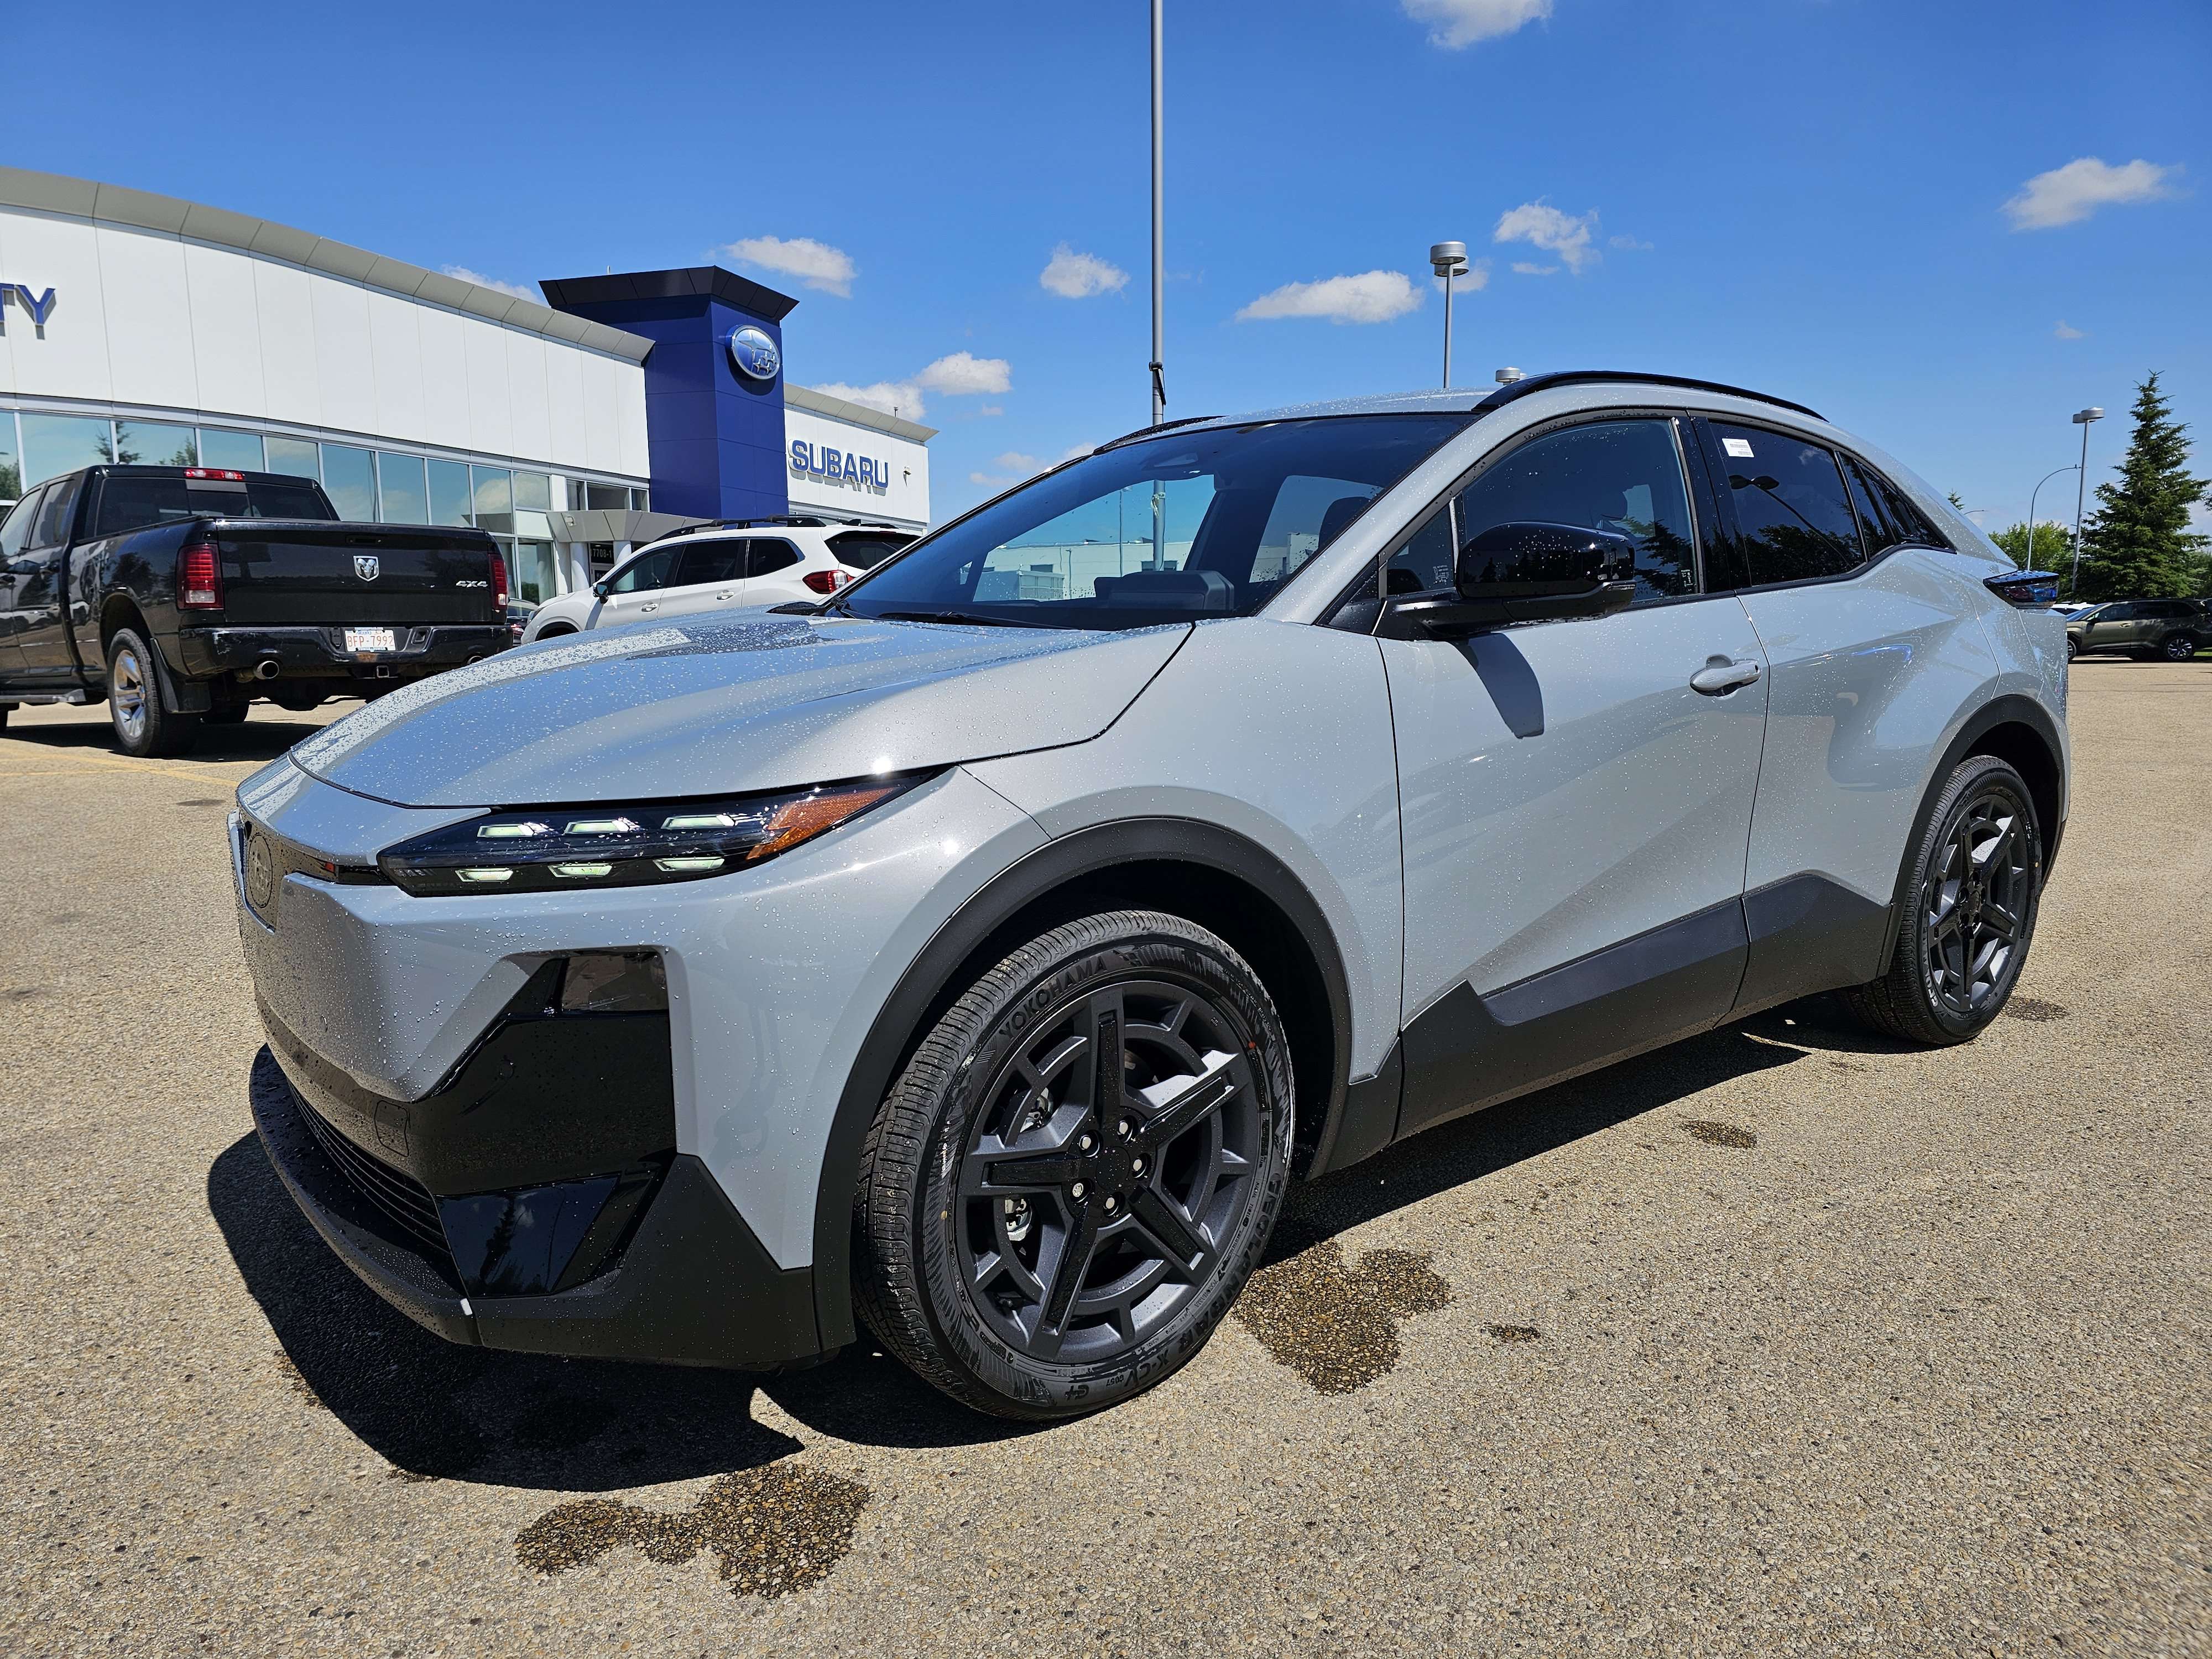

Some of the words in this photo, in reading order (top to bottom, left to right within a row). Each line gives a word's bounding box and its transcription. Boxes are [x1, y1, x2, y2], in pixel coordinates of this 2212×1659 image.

[789, 439, 889, 489] SUBARU
[347, 635, 394, 647] BFP-7992
[999, 955, 1108, 1041] YOKOHAMA
